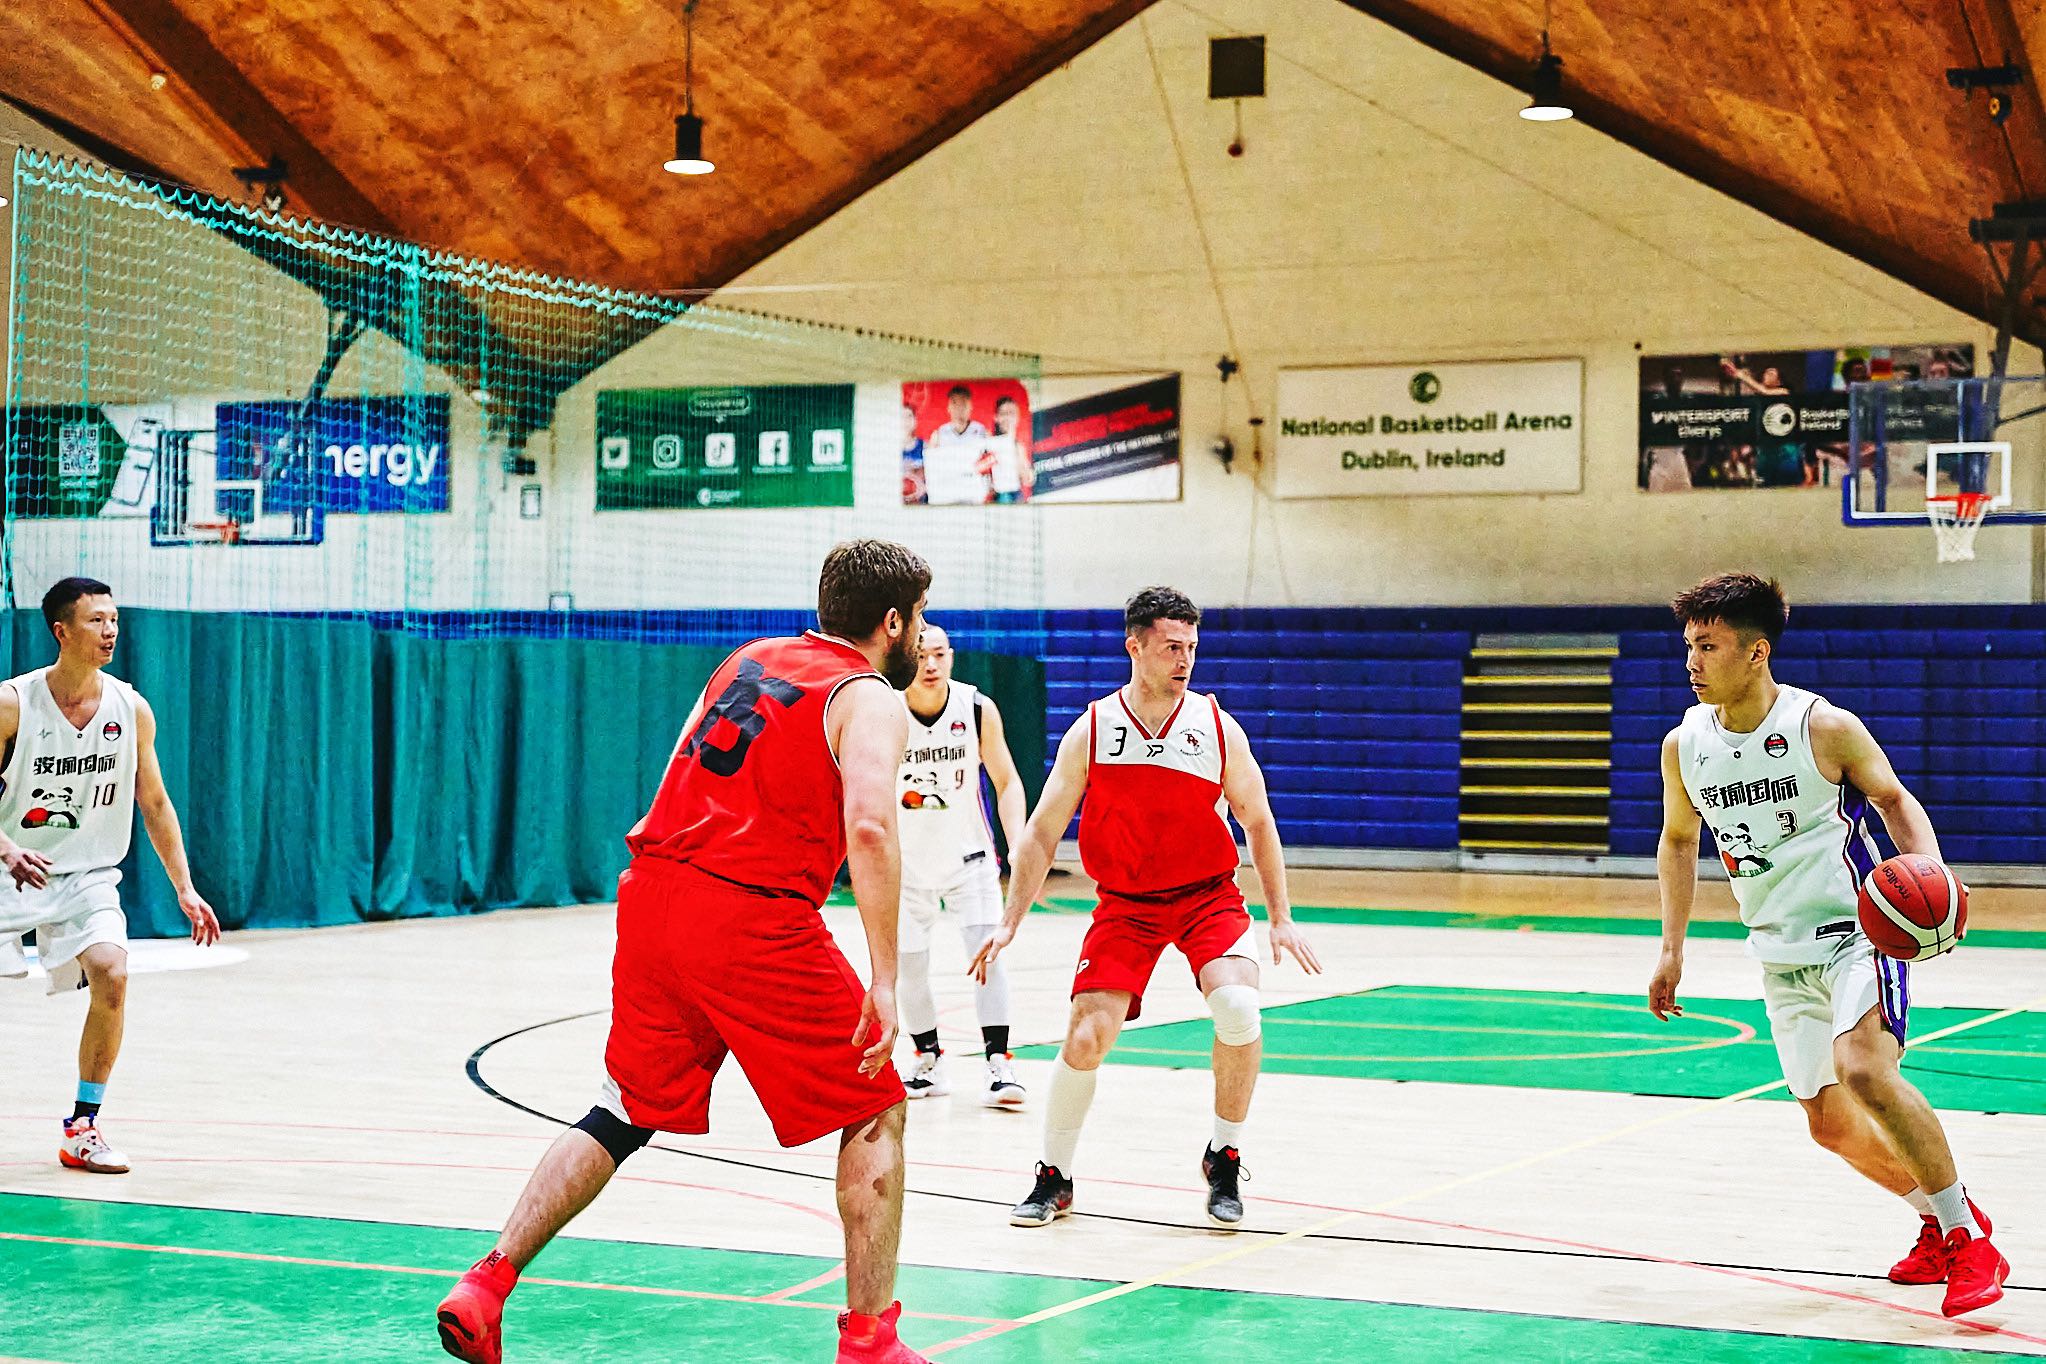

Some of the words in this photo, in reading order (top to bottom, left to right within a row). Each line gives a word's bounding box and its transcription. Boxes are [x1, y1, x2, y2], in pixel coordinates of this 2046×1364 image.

[1281, 415, 1374, 436] National
[1380, 412, 1498, 433] Basketball
[1504, 411, 1573, 430] Arena
[1341, 449, 1419, 471] Dublin,
[1425, 448, 1506, 467] Ireland
[1108, 726, 1128, 757] 3
[92, 782, 119, 809] 10
[1776, 809, 1799, 840] 3
